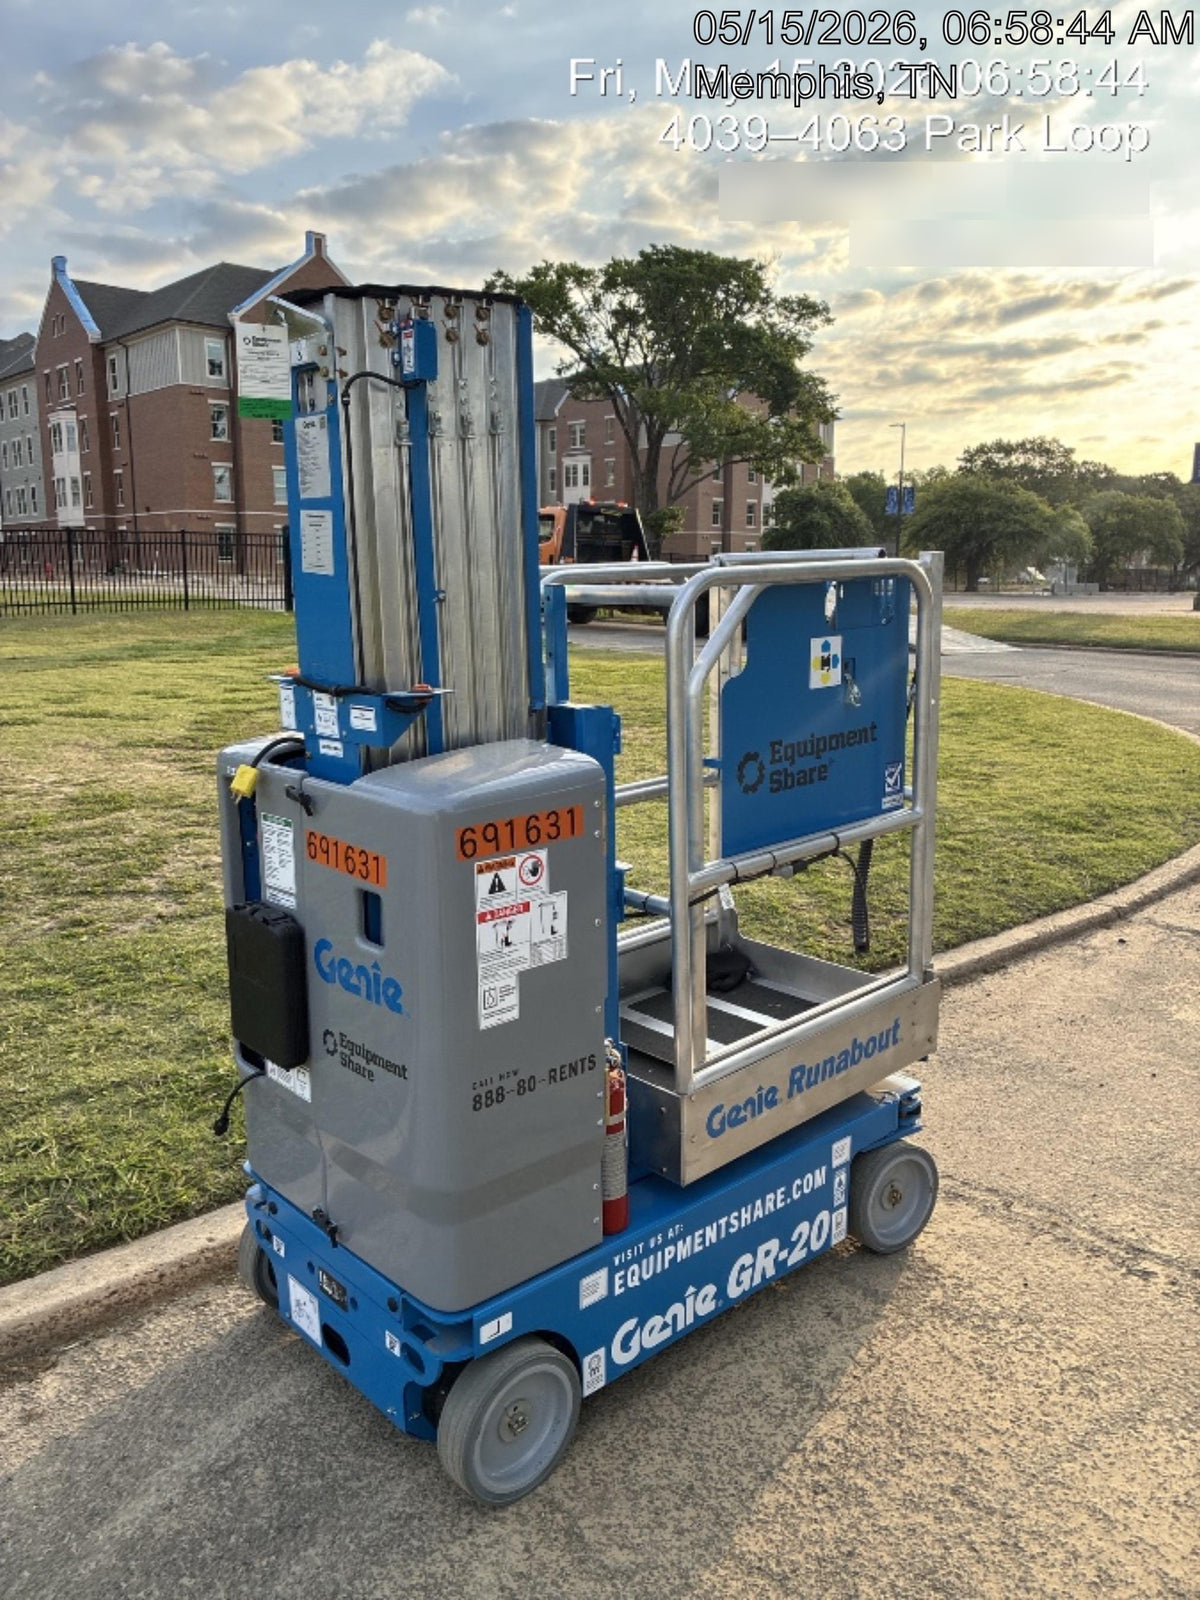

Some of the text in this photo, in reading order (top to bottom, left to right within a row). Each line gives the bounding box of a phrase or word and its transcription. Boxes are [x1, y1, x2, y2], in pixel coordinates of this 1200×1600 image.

[769, 721, 878, 766] Equipment
[769, 763, 829, 794] Share
[307, 830, 380, 885] 691631
[459, 808, 576, 859] 691631
[314, 938, 403, 1015] Genie
[339, 1031, 408, 1080] Equipment
[340, 1051, 375, 1083] Share
[706, 1017, 901, 1139] Genie Runabout
[472, 1054, 597, 1112] 888-80-RENTS
[612, 1224, 684, 1267] VISIT US AT:
[614, 1165, 827, 1297] EQUIPMENTSHARE.COM
[611, 1209, 831, 1366] Genie GR-20
